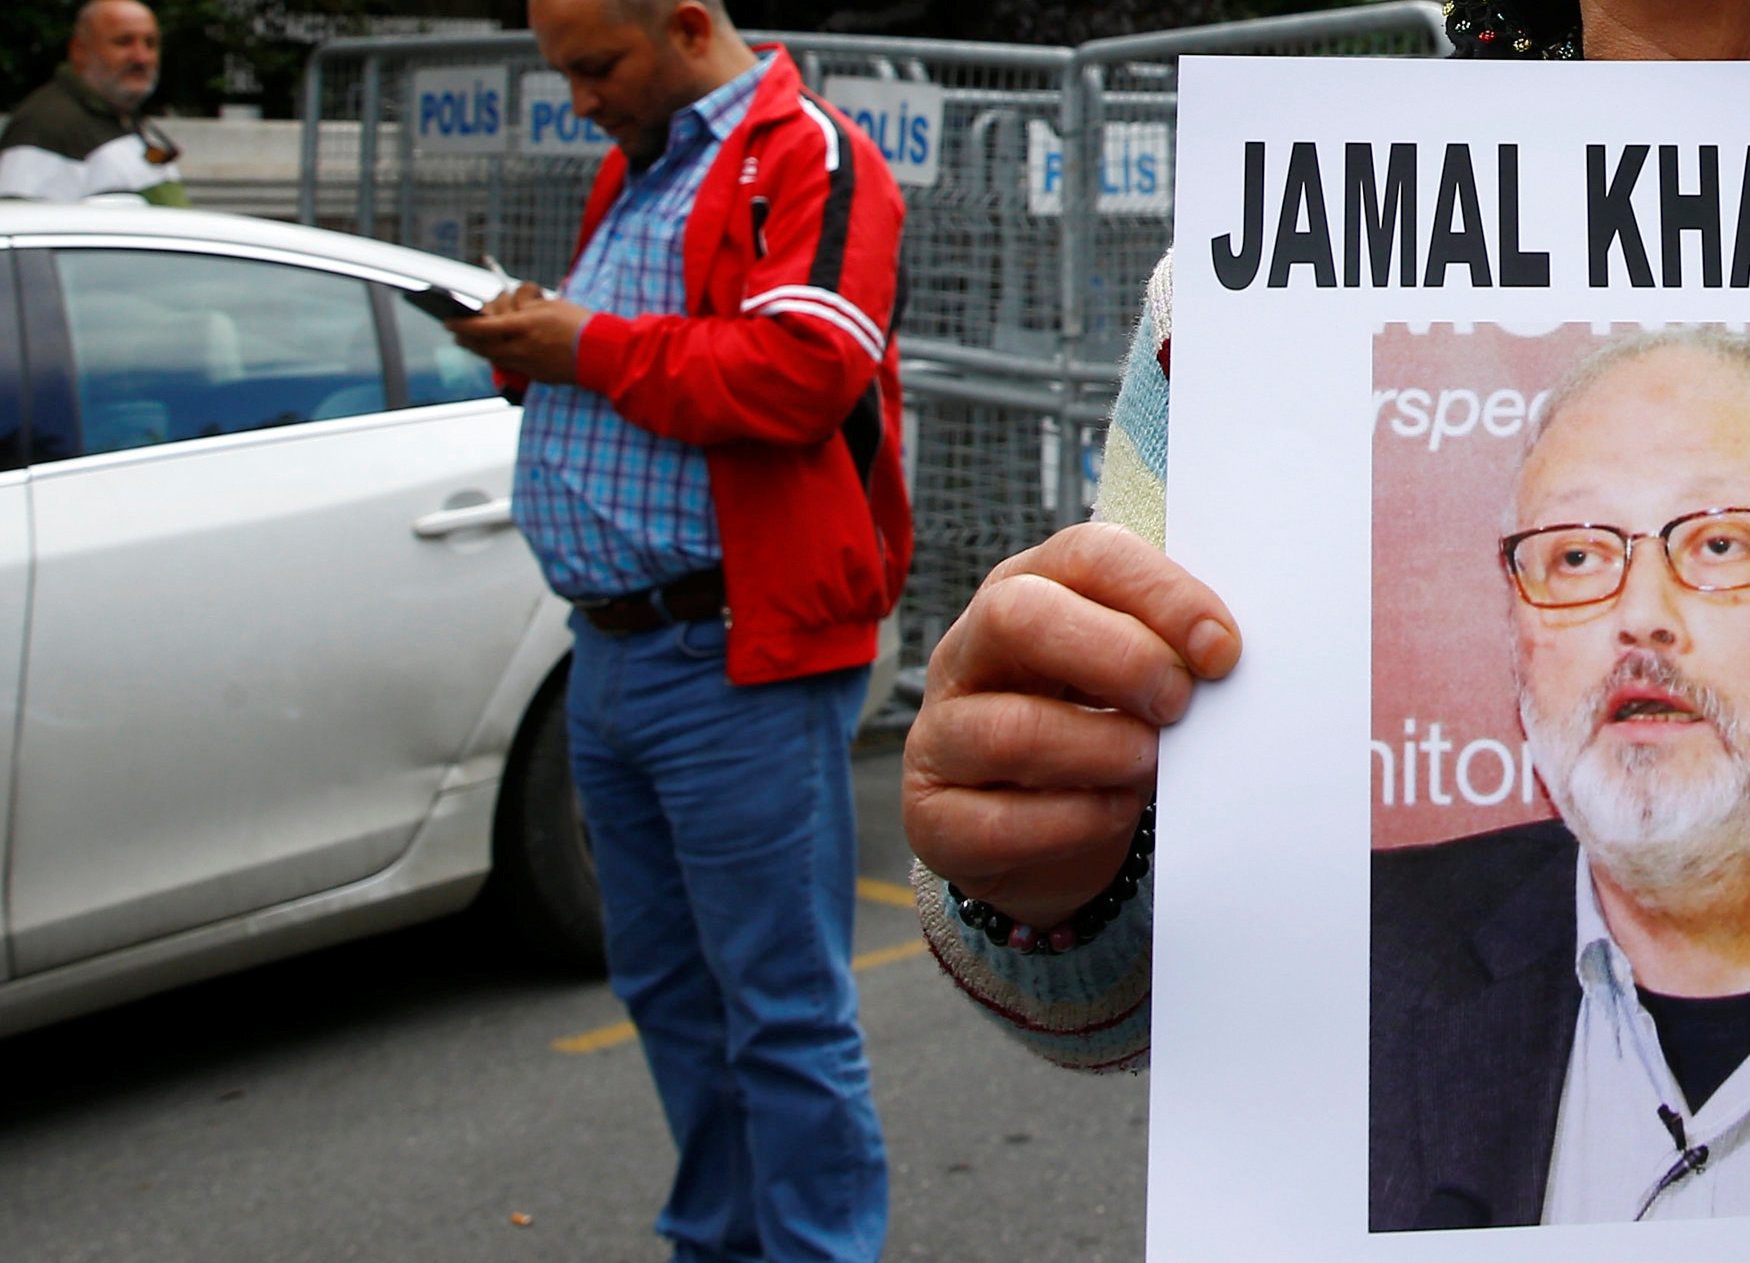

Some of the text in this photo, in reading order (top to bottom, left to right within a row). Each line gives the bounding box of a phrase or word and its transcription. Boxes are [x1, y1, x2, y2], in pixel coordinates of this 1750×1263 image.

[419, 80, 500, 136] POLİS
[1044, 139, 1157, 194] PLİS
[1211, 141, 1550, 291] JAMAL
